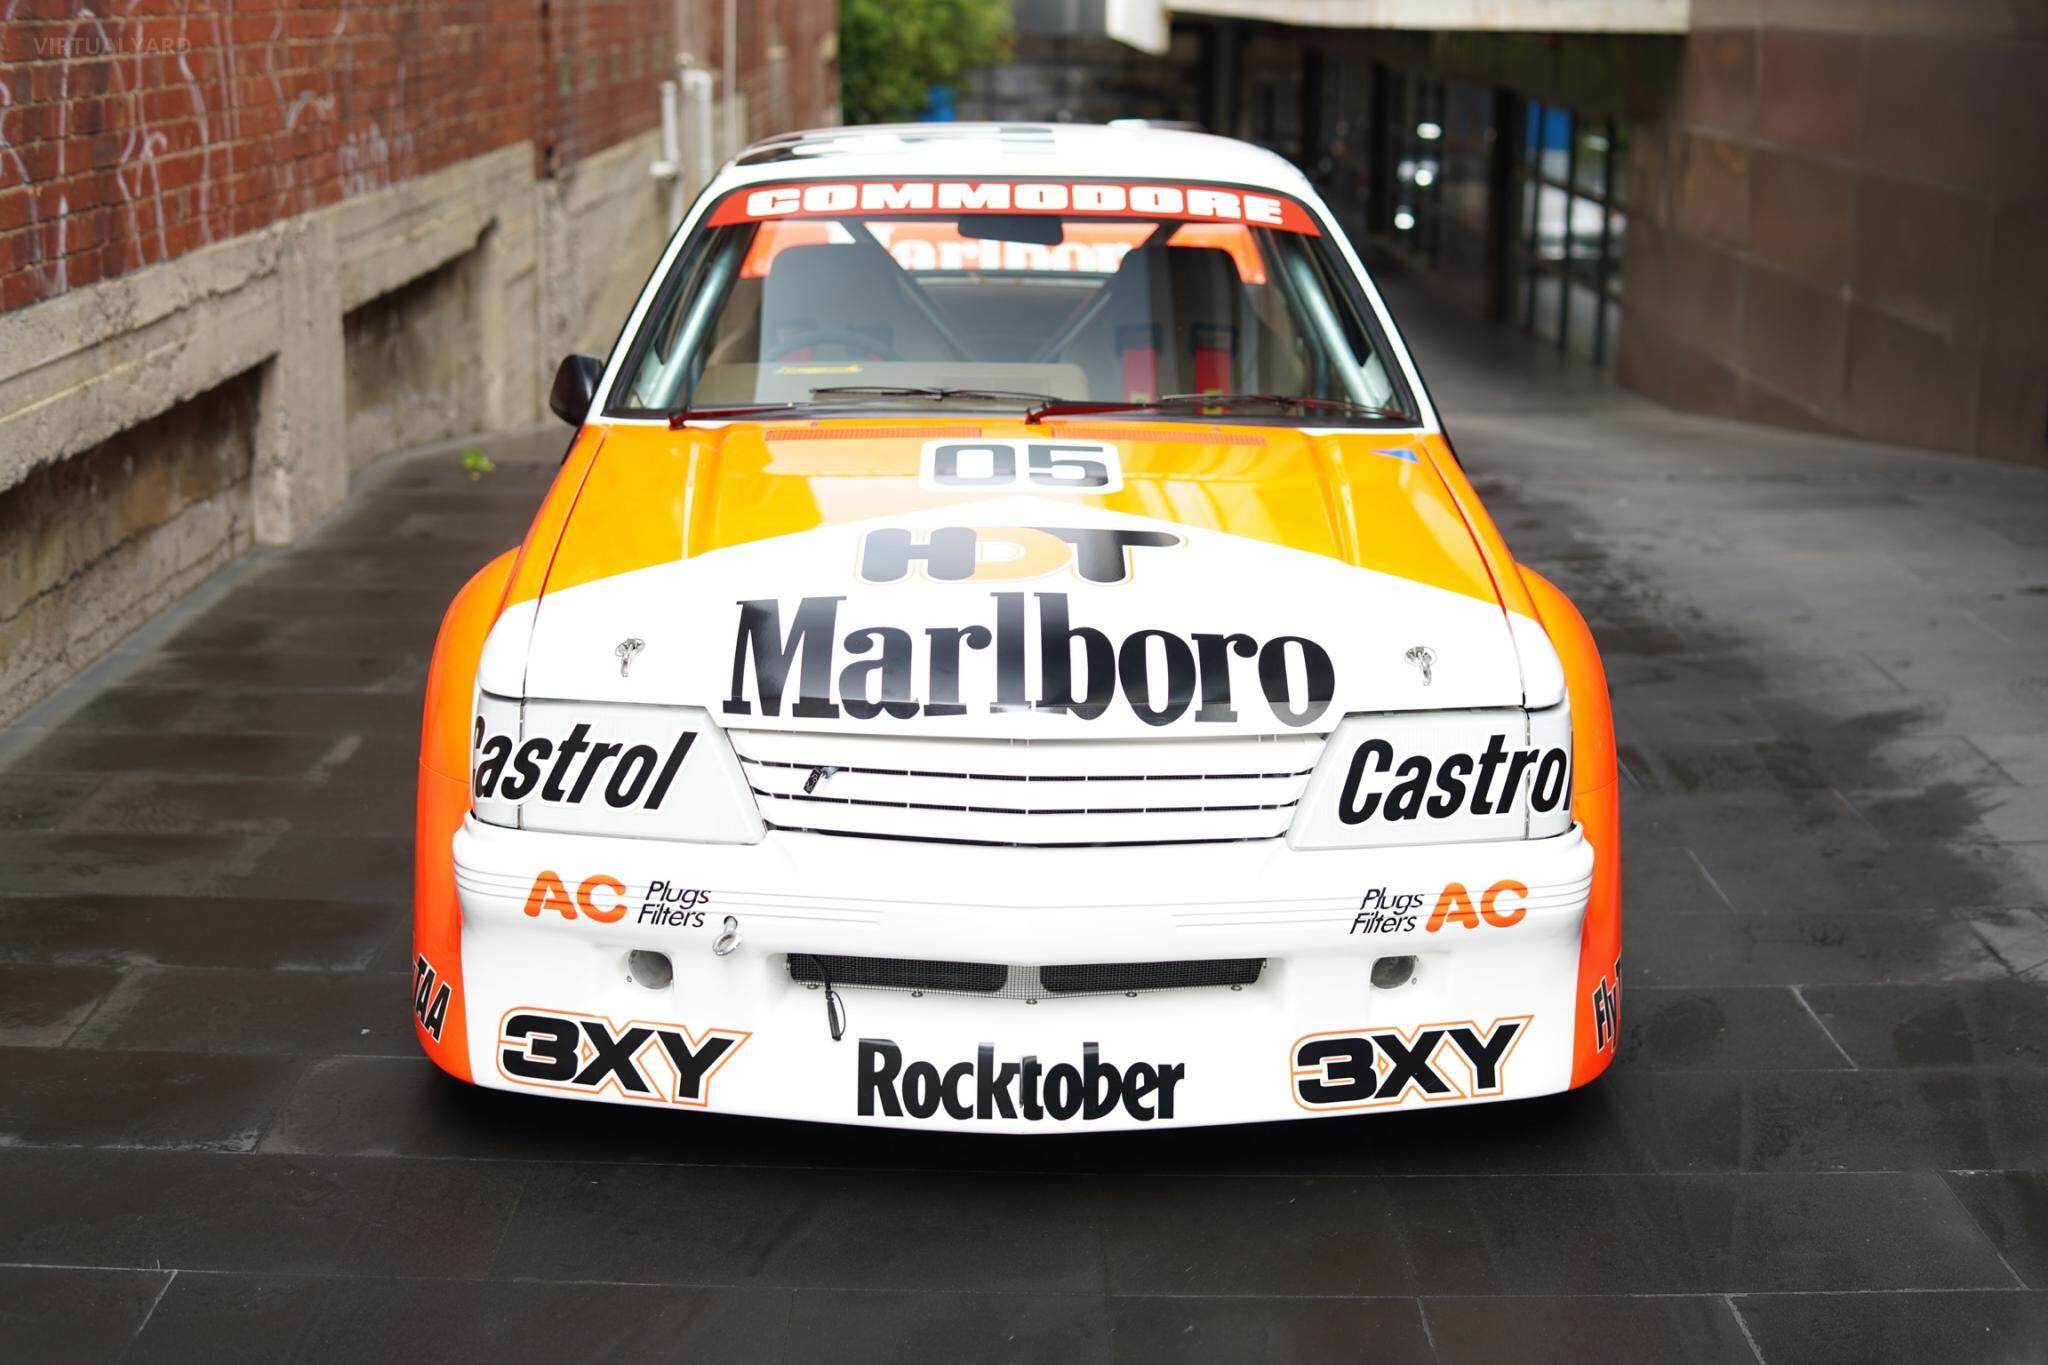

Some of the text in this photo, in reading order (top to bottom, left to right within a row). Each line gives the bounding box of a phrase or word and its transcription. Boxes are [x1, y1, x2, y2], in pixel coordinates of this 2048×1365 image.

[746, 183, 1284, 225] COMMODORE
[933, 444, 1109, 488] 05
[860, 526, 1181, 583] HDT
[722, 591, 1336, 727] Marlboro
[523, 870, 628, 924] AC
[637, 903, 706, 928] Filters
[645, 880, 711, 910] Plugs
[1360, 886, 1424, 916] Plugs
[1425, 879, 1529, 933] AC
[1349, 910, 1418, 935] Filters
[500, 1012, 737, 1100] 3XY
[857, 1038, 1185, 1121] Rocktober
[1296, 1021, 1522, 1106] 3XY
